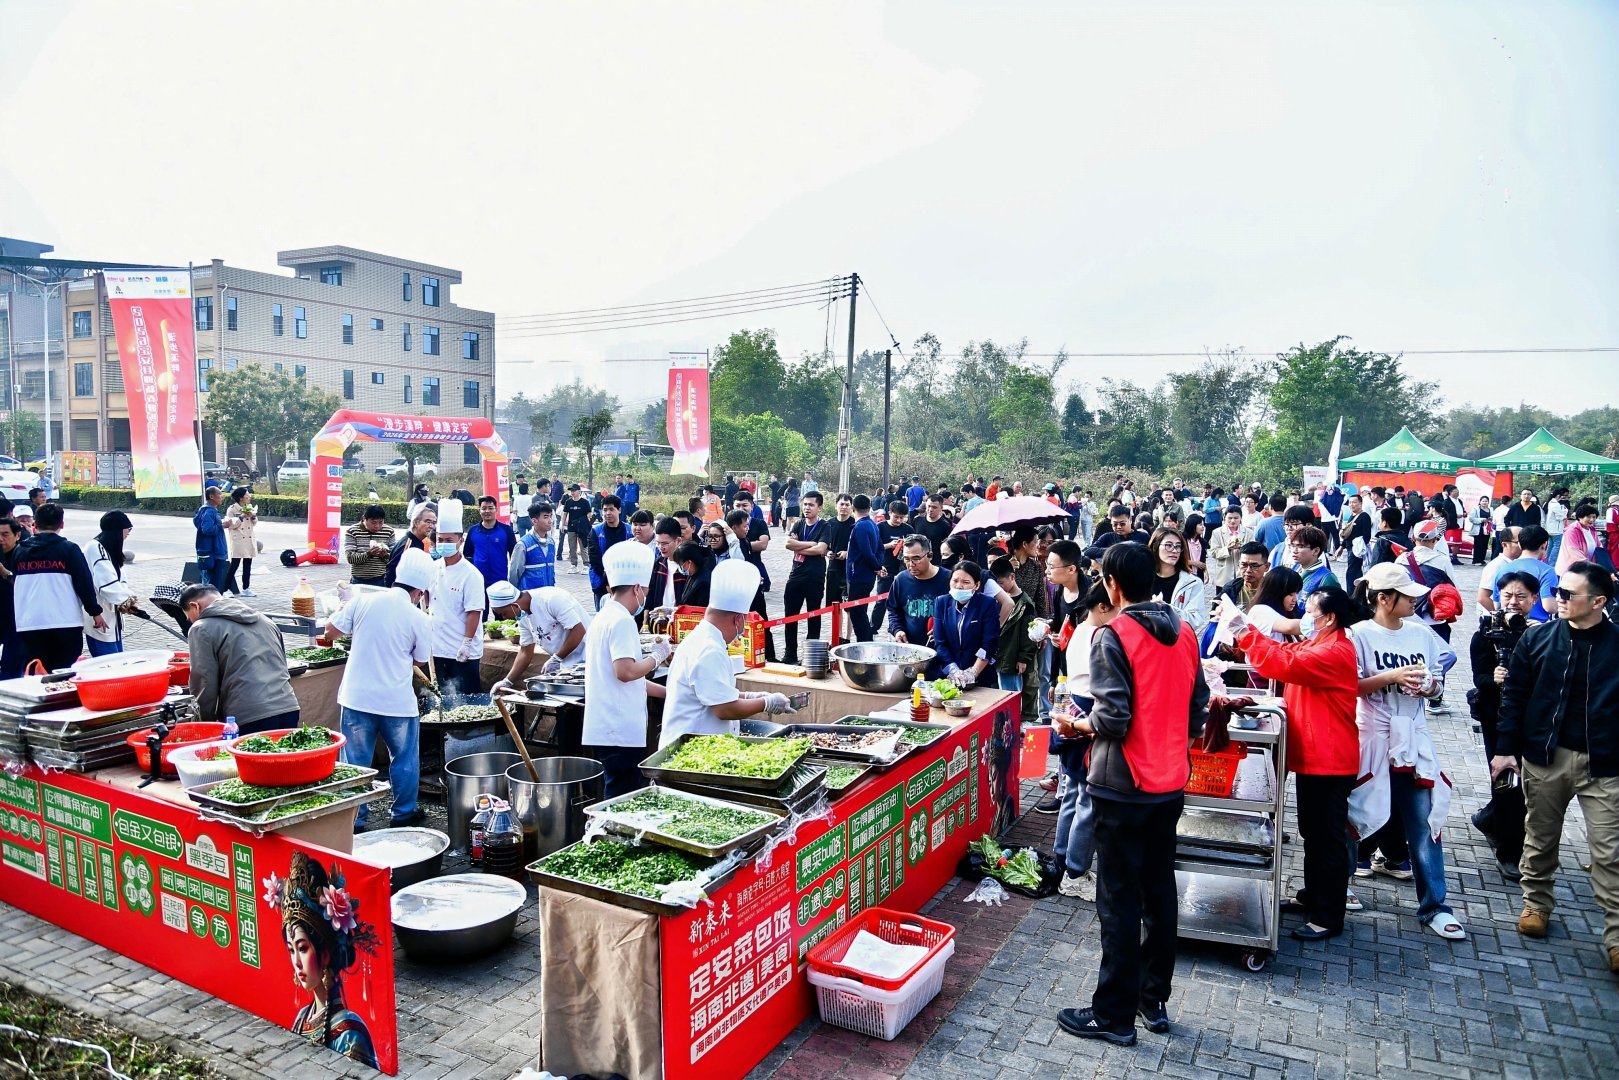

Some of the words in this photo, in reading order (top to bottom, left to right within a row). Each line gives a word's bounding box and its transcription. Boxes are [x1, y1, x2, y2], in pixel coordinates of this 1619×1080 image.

[27, 560, 66, 571] JORDAN
[118, 817, 178, 852] 包金又包银
[189, 847, 227, 875] 黑季豆
[798, 874, 844, 921] 非遗美食
[192, 910, 205, 929] 争
[688, 900, 733, 944] 新泰来
[240, 915, 258, 964] 油菜
[690, 901, 791, 1005] 定安菜包饭
[699, 942, 709, 955] XIN
[710, 935, 720, 946] TAI
[720, 928, 730, 940] LAI
[695, 970, 788, 1057] 海南省非物质文化遗产美食
